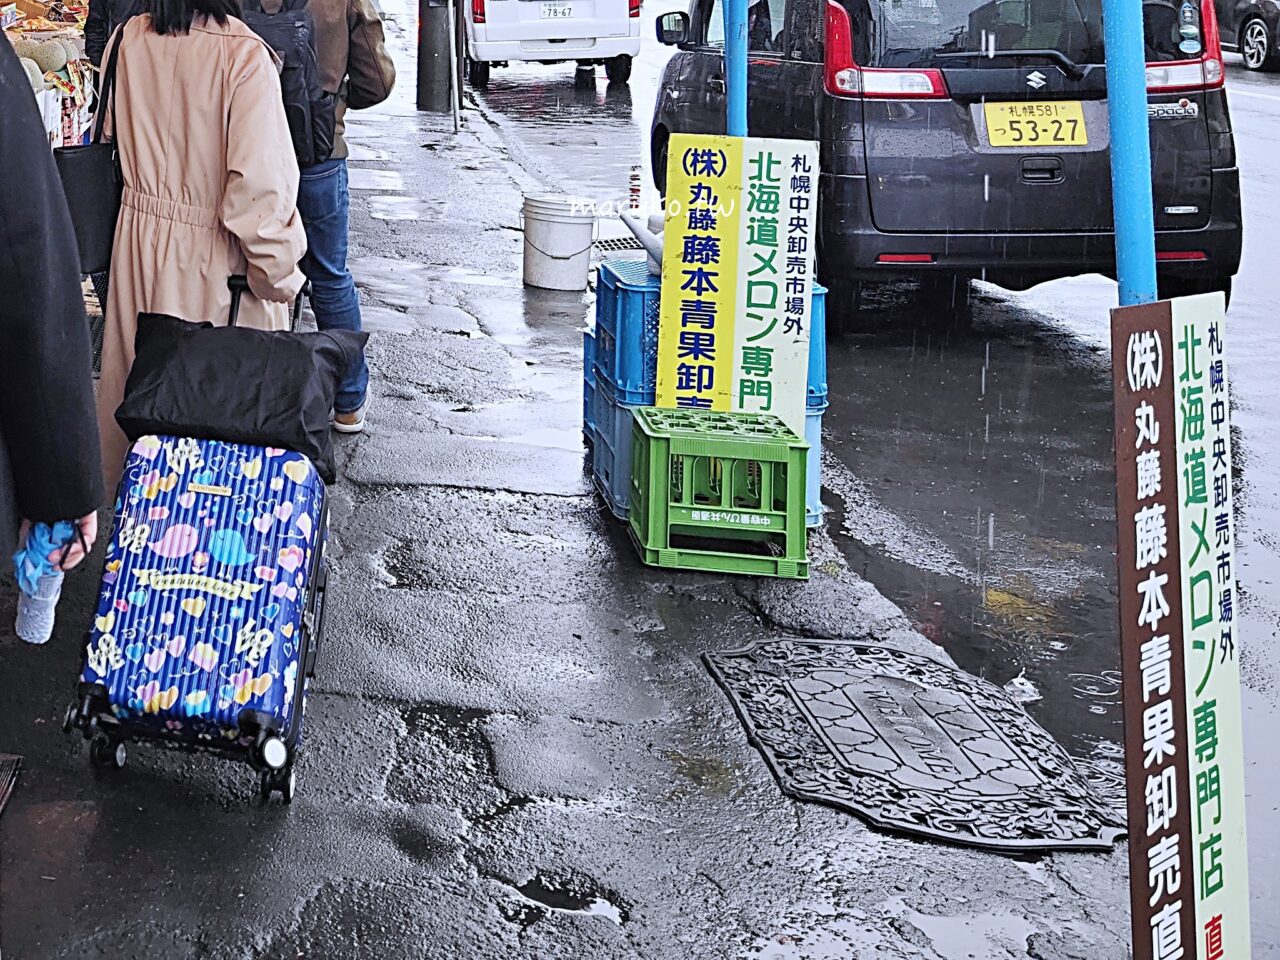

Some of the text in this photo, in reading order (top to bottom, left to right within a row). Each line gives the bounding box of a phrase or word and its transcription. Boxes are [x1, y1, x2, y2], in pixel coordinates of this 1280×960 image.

[994, 119, 1078, 142] つ 53-27
[1008, 104, 1059, 117] 札幌 581
[737, 150, 782, 411] 北海道メロン専門
[782, 153, 813, 336] 札幌中央卸売市場外
[1207, 320, 1235, 667] 札幌中央卸売市場外
[1177, 323, 1225, 902] 北海道メロン専門店
